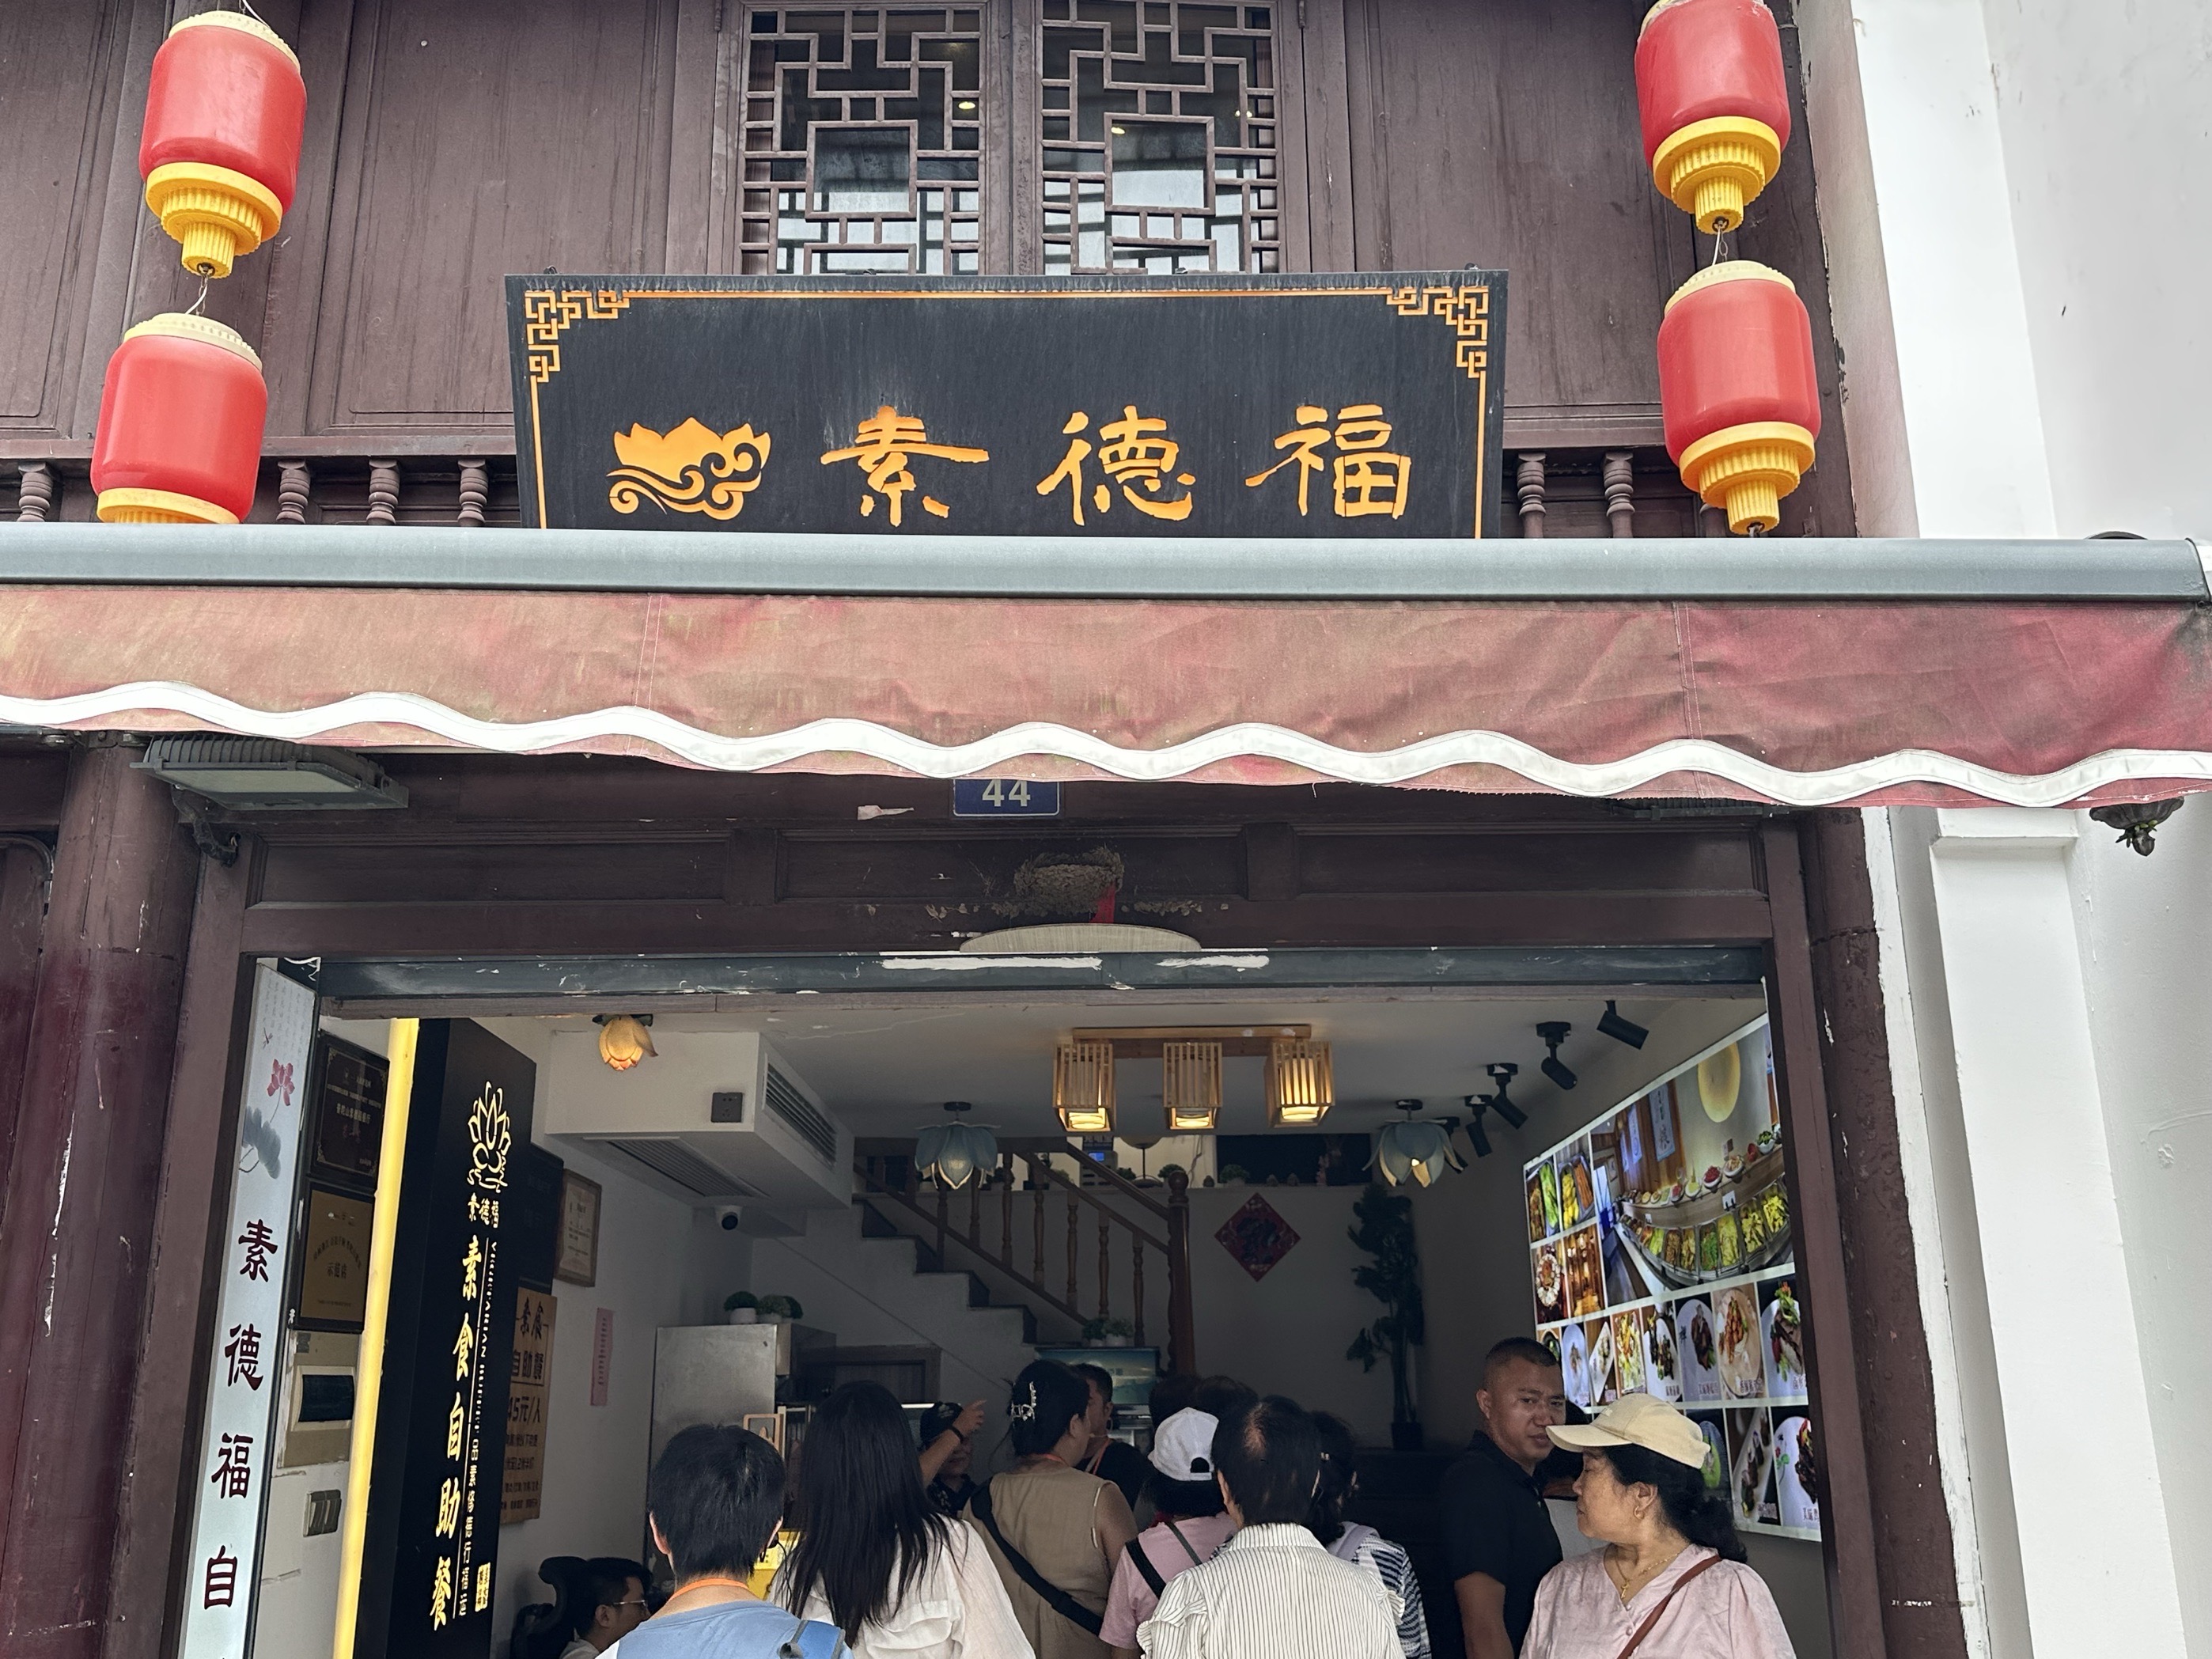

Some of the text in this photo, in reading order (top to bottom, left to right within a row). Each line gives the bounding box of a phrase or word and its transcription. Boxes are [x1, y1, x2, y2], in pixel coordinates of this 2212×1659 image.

[822, 405, 1410, 523] 素德福
[982, 779, 1031, 807] 44
[468, 1192, 499, 1228] 素德福
[521, 1297, 544, 1339] 素食
[512, 1350, 544, 1380] 自助餐
[430, 1235, 482, 1631] 素食自助餐
